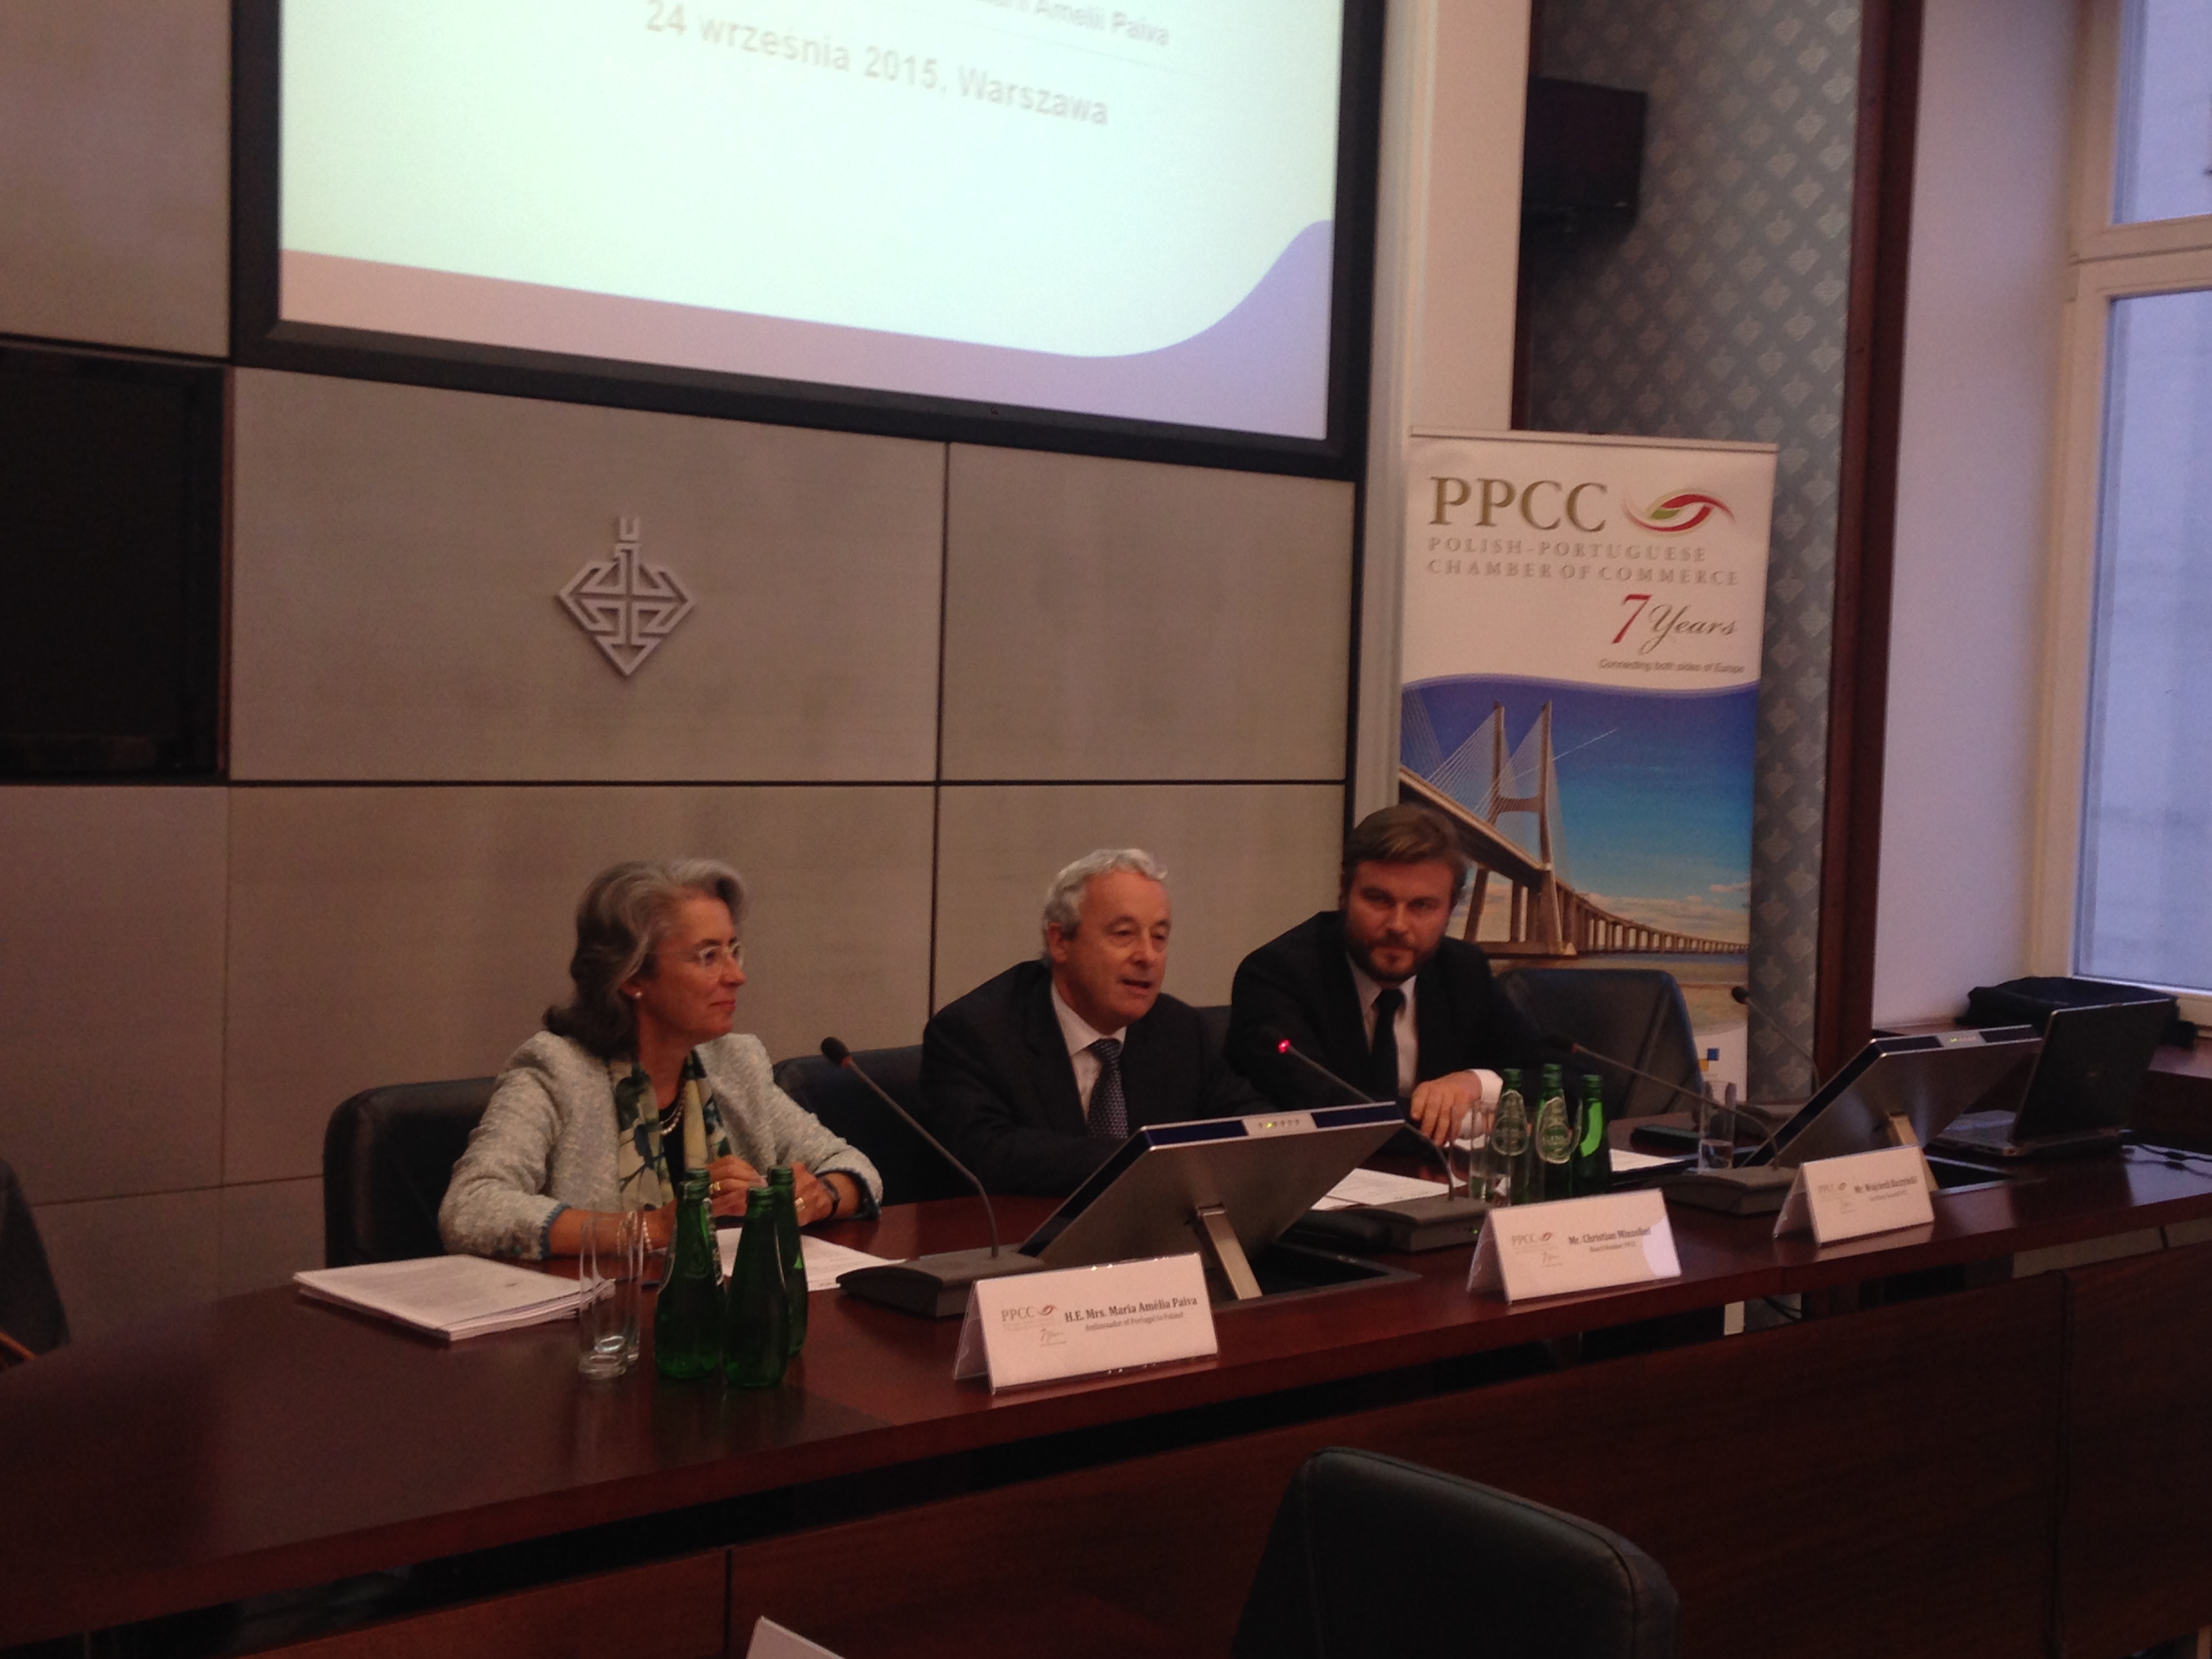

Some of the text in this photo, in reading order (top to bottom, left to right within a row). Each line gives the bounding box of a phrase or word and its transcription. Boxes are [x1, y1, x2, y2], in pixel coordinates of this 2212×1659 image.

[644, 0, 687, 35] 24
[958, 64, 1109, 126] Warszawa
[1428, 476, 1608, 533] PPCC
[1426, 558, 1740, 586] CHAMBER OF COMMERCE
[1611, 593, 1737, 655] 7 Years
[1654, 660, 1674, 671] both
[1582, 1232, 1617, 1244] Christian
[1002, 1305, 1036, 1322] PPCC
[1064, 1296, 1197, 1322] H.E. Mrs. Maria Amélia Paiva
[1085, 1319, 1122, 1332] Ambassador
